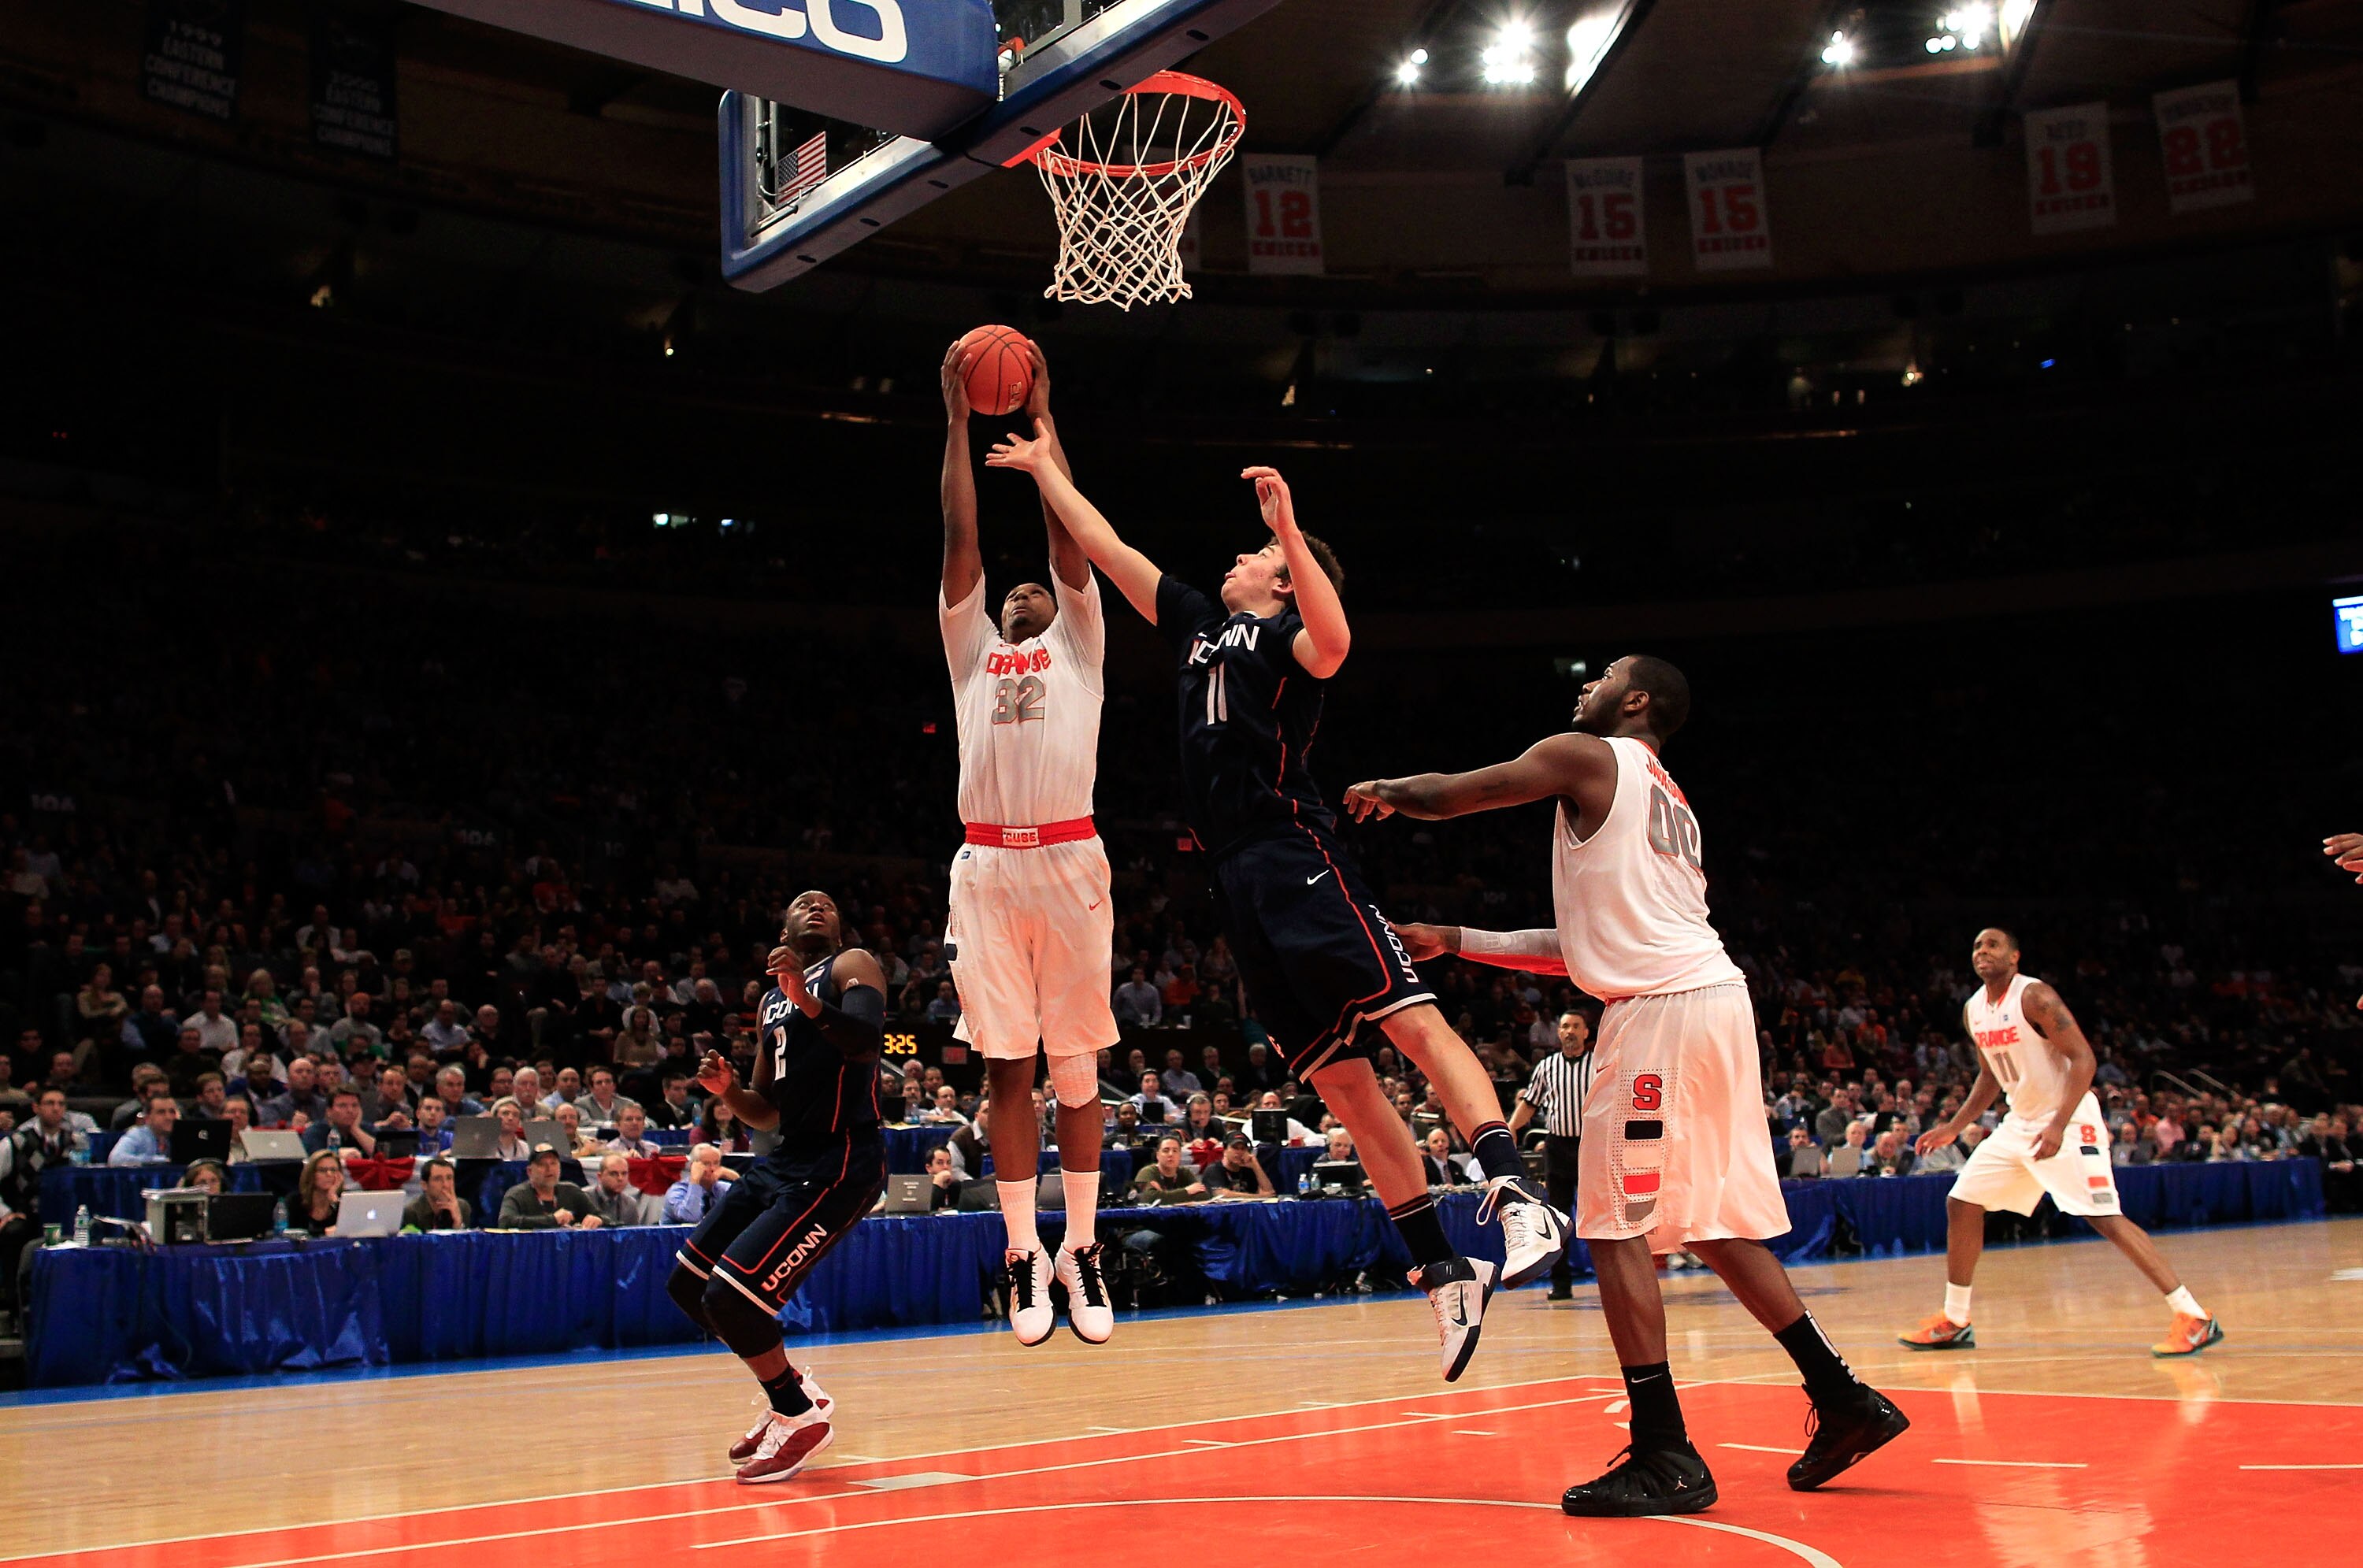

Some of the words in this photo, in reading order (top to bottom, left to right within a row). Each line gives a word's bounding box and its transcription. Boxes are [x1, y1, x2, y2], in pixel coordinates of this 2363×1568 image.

[1248, 165, 1311, 183] BARNETT
[2036, 142, 2101, 195] 19
[1254, 189, 1313, 238] 12
[1578, 193, 1636, 240] 15
[1697, 185, 1758, 234] 15
[990, 676, 1046, 725] 32
[1207, 661, 1228, 725] 11
[1649, 783, 1702, 874] 00
[1368, 904, 1419, 983] UCONN
[773, 1025, 787, 1081] 2
[883, 1033, 918, 1055] 3:25
[1993, 1050, 2020, 1083] 11
[1632, 1073, 1663, 1111] S
[761, 1222, 827, 1292] UCONN
